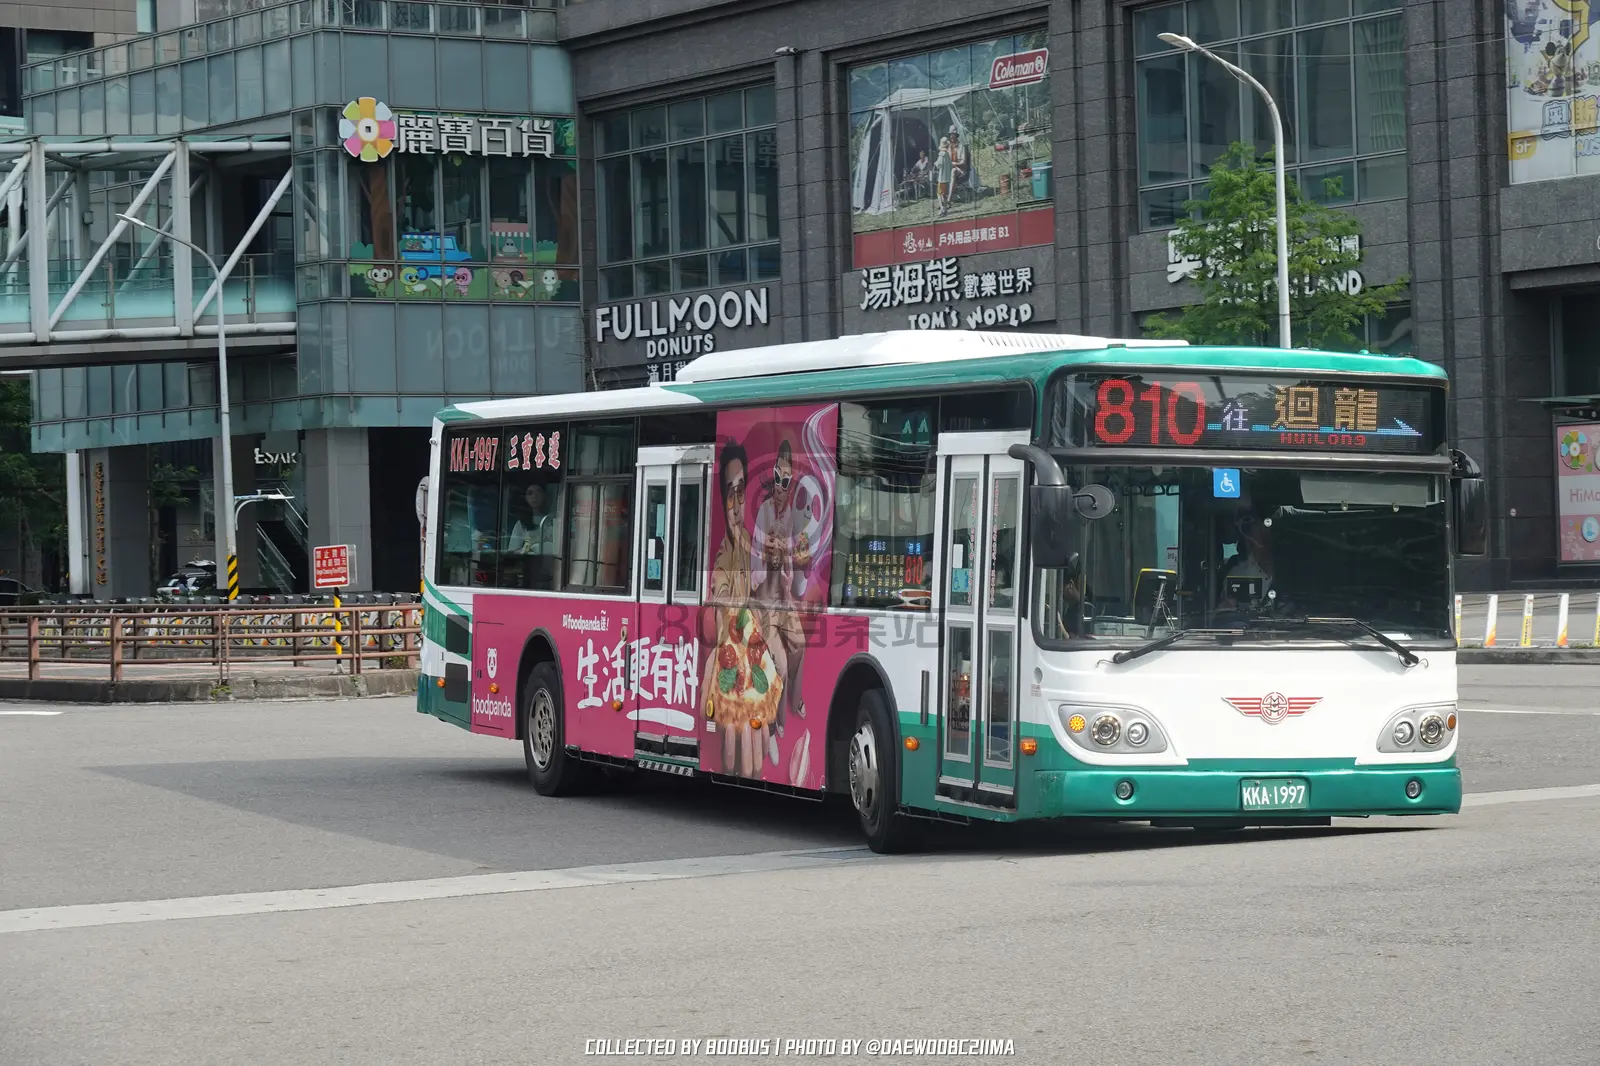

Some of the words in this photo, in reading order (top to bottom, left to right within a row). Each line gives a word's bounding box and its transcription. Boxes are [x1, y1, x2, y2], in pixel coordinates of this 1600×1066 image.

[994, 60, 1035, 81] Coleman
[398, 114, 552, 158] 麗寶百貨
[1515, 142, 1532, 154] 5F
[939, 227, 997, 247] 戶外用品專賣店
[998, 226, 1010, 238] B1
[860, 257, 960, 310] 湯姆熊
[964, 267, 1032, 299] 歡樂世界
[596, 287, 768, 342] FULLMOON
[908, 306, 958, 330] TOM'S
[966, 303, 1032, 330] WORLD
[647, 334, 714, 358] DONUTS
[1094, 379, 1206, 445] 810
[1223, 402, 1249, 431] 往
[449, 437, 499, 471] KKA-1997
[508, 431, 561, 470] 三重客運
[905, 556, 923, 585] 810
[577, 635, 699, 709] 生活更有料
[473, 692, 512, 721] foodpanda
